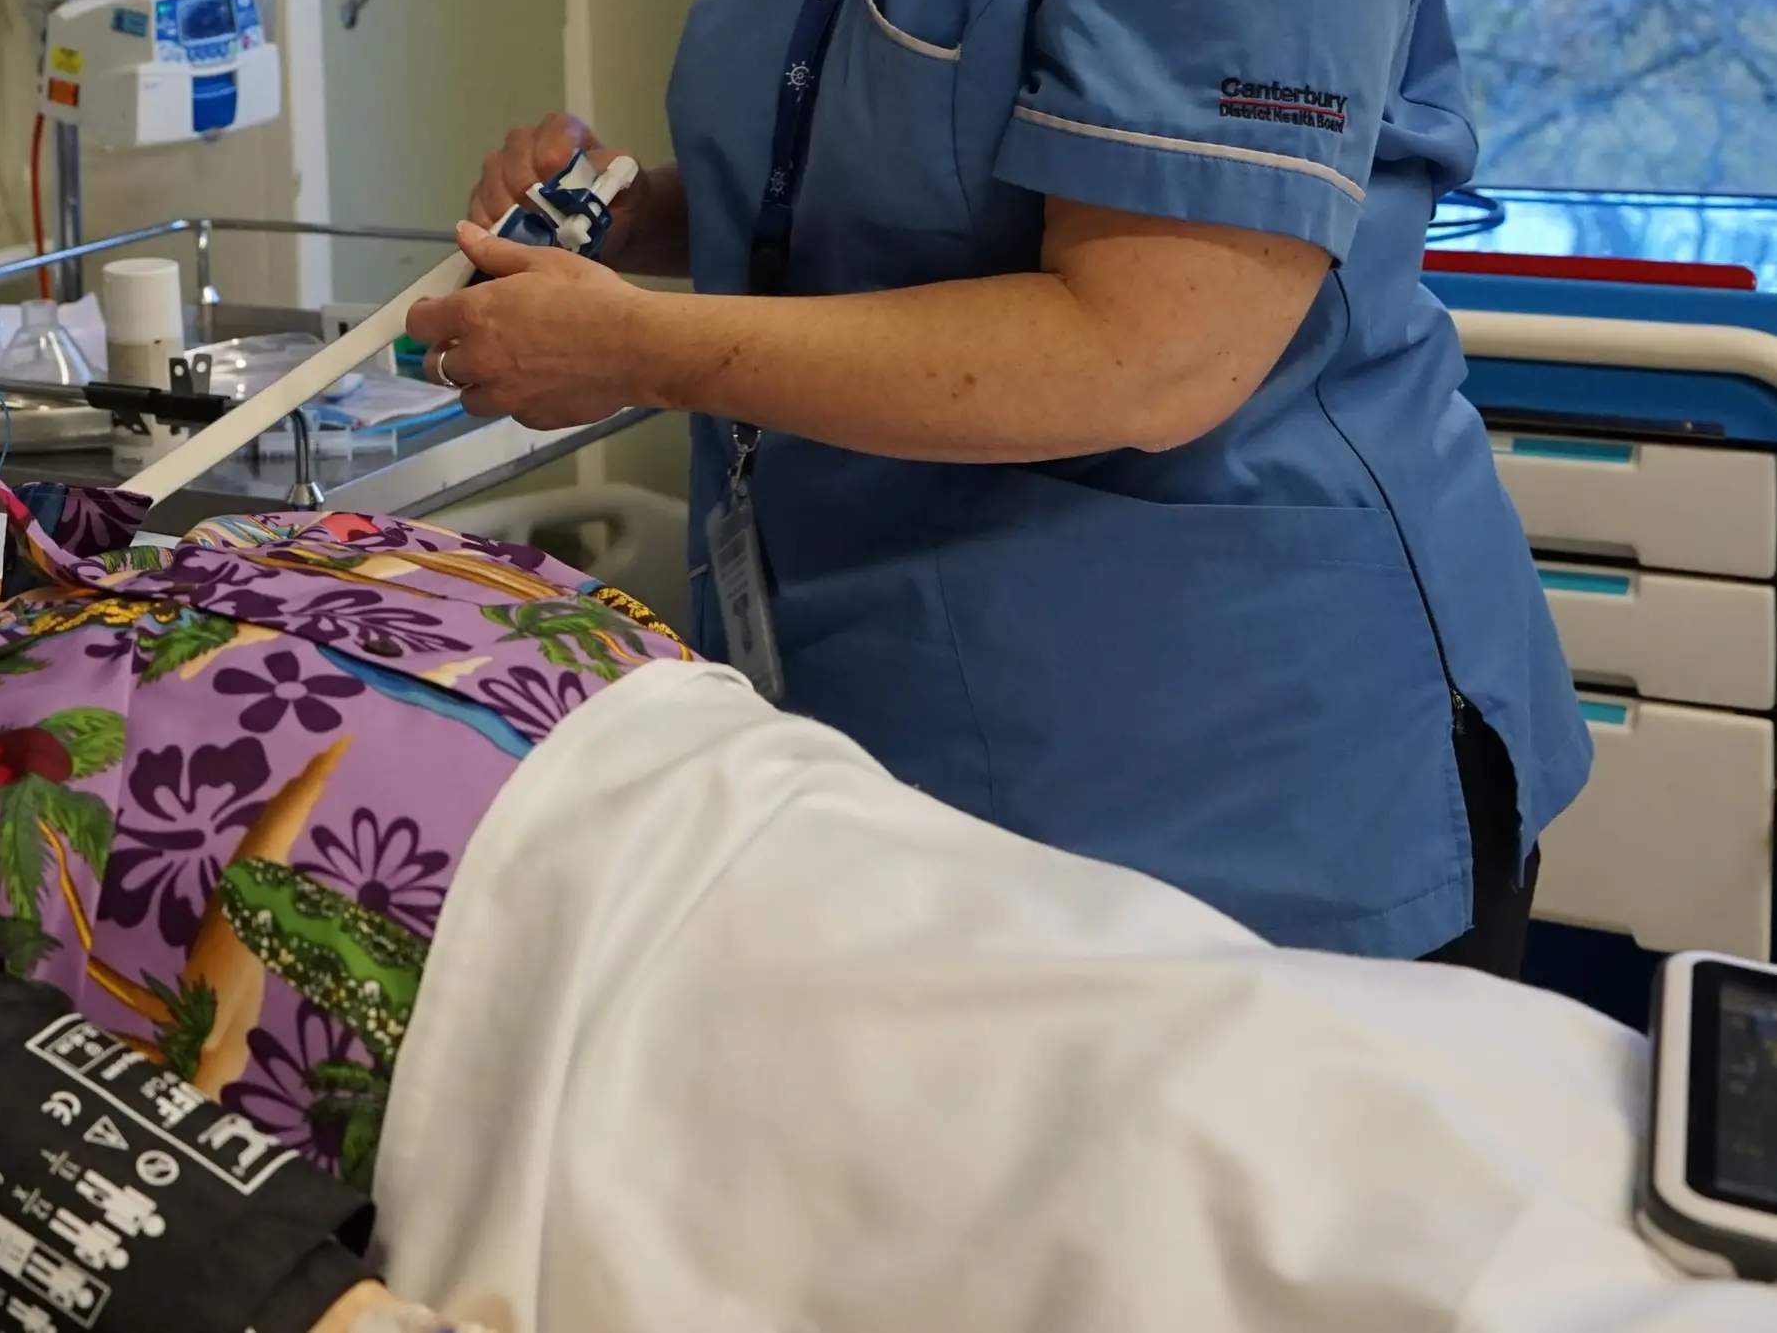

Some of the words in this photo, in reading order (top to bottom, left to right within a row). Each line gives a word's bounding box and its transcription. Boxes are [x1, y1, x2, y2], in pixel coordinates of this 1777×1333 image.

[1220, 76, 1348, 114] Canterbury
[1273, 109, 1315, 127] Health
[1317, 113, 1345, 134] Board
